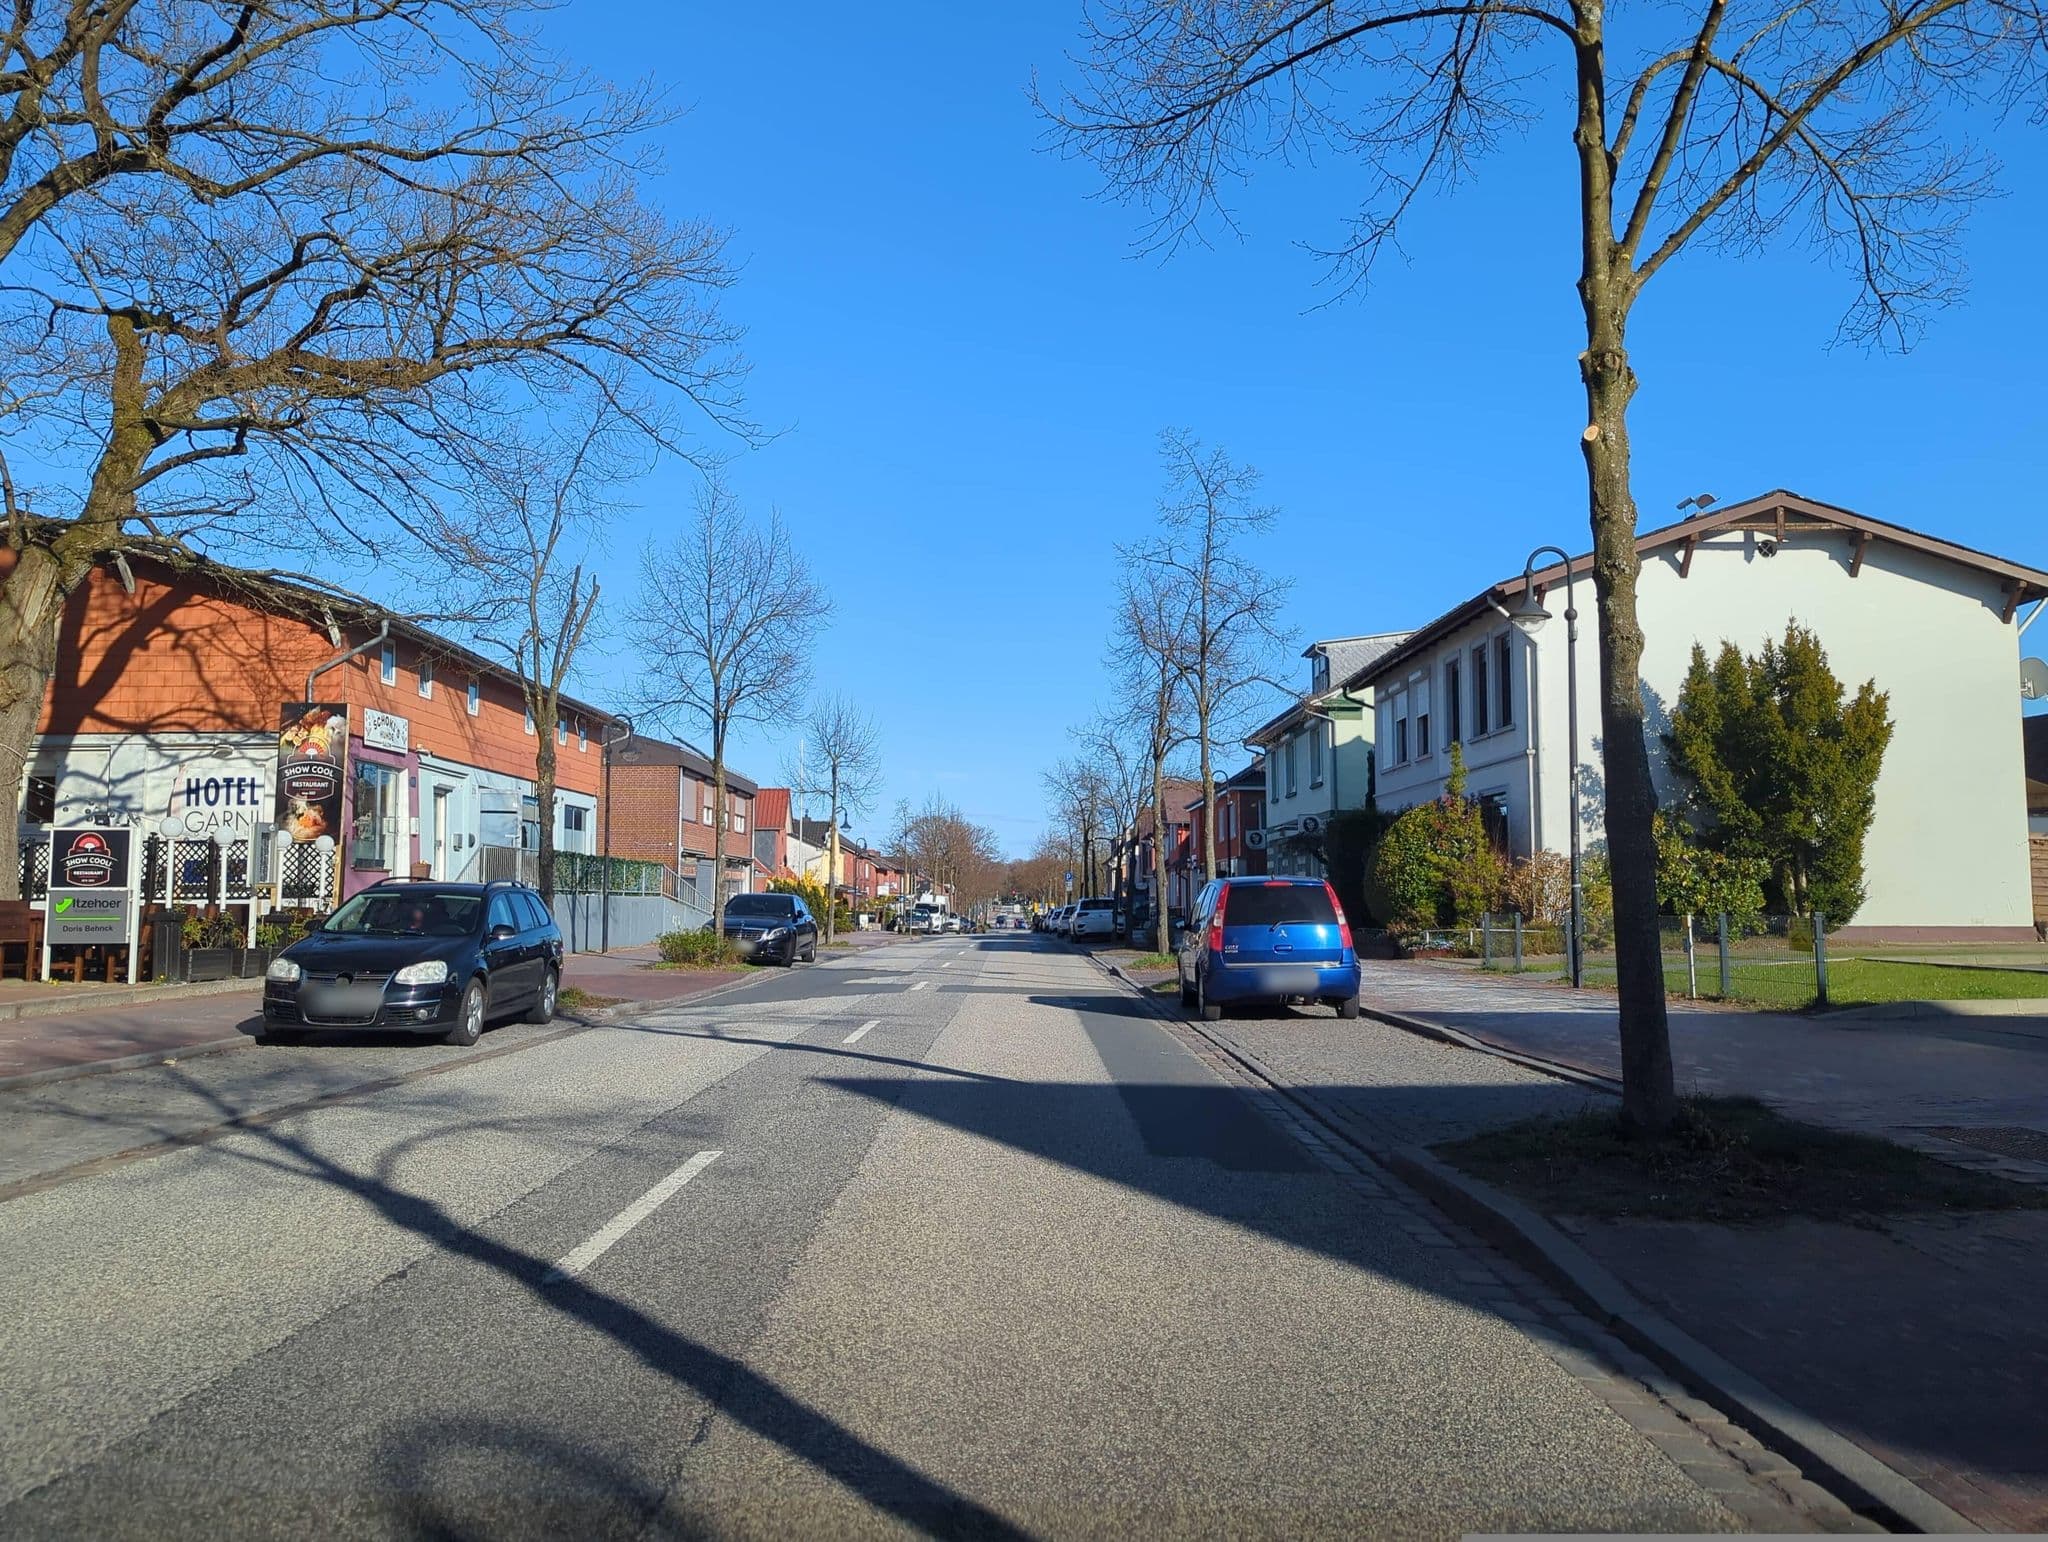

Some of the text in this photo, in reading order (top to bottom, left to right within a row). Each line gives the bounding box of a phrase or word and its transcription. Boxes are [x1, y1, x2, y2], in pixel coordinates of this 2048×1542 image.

[284, 765, 310, 777] SHOW
[186, 777, 259, 807] HOTEL
[184, 810, 259, 832] GARNI
[65, 857, 88, 867] SHOW
[72, 898, 121, 909] Itzehoer
